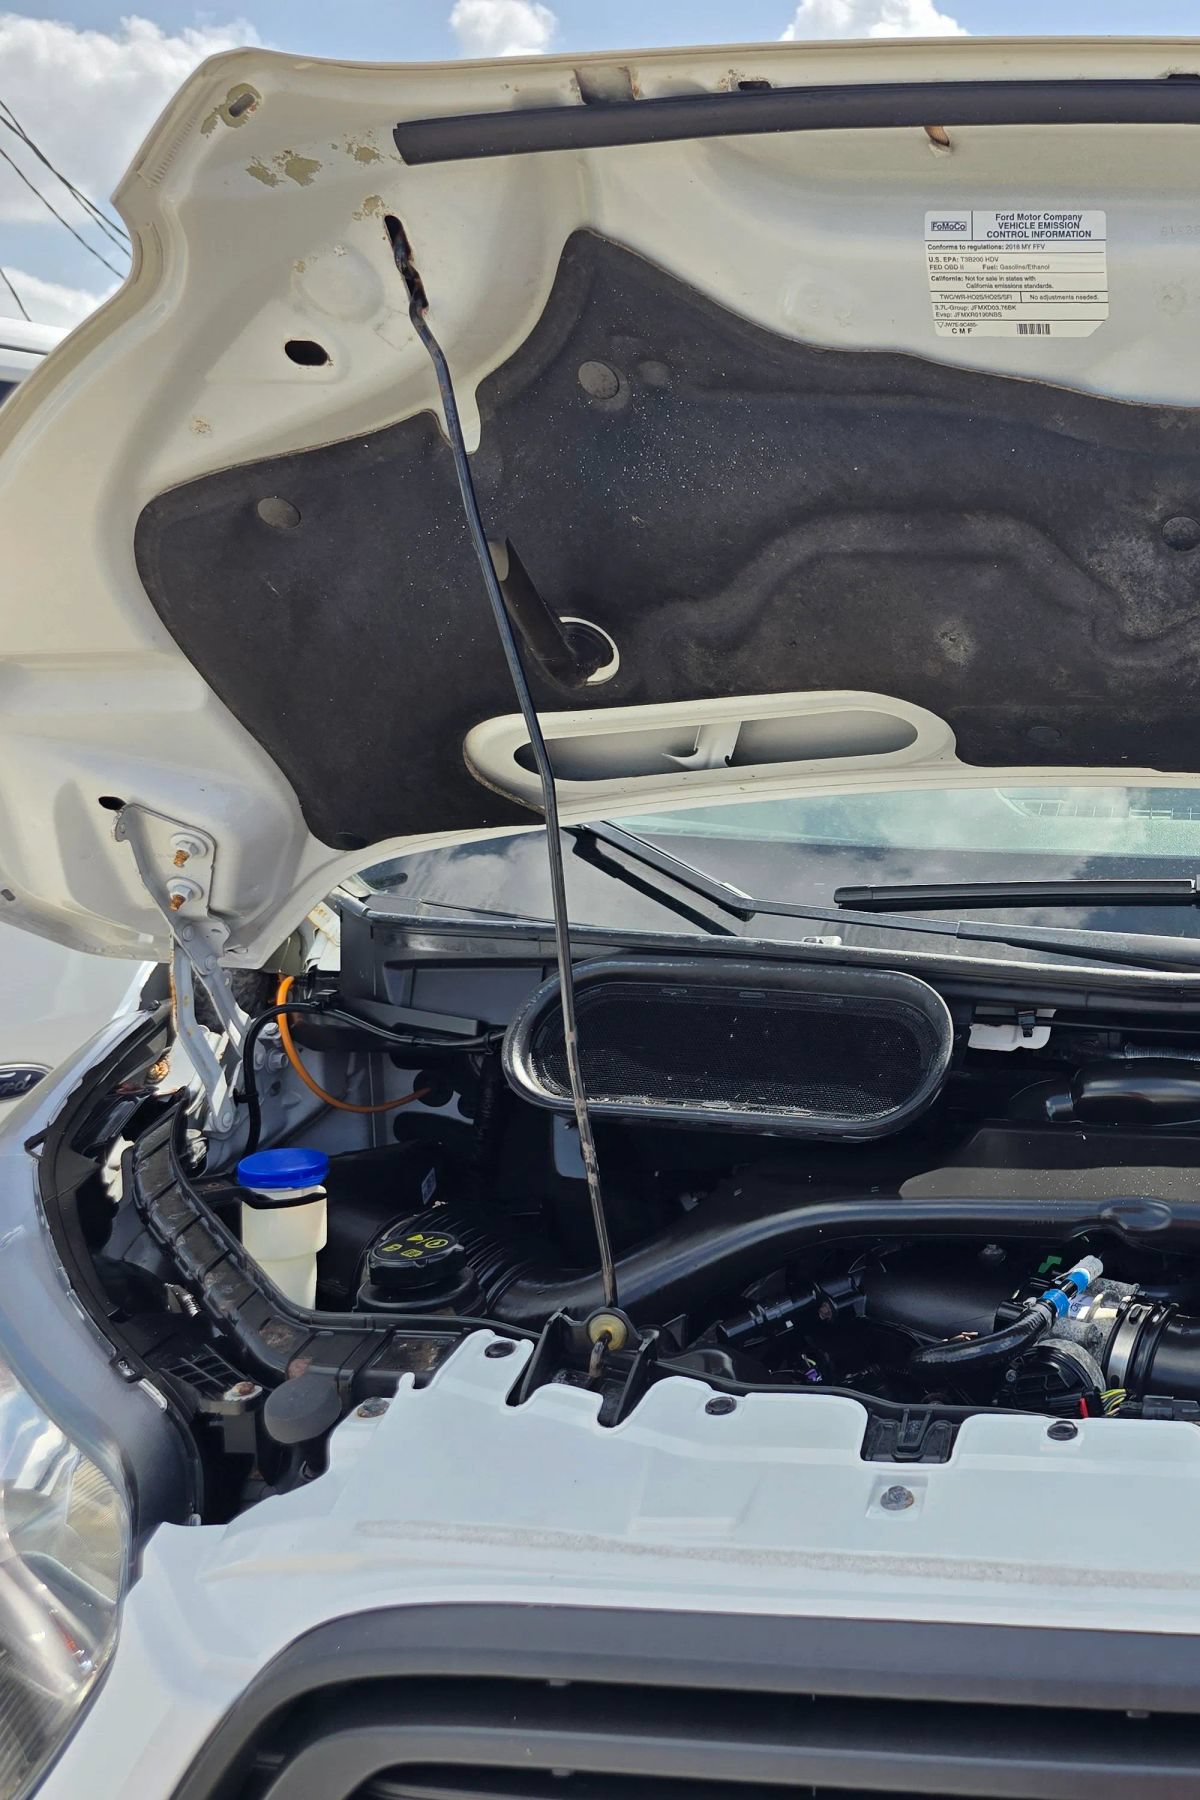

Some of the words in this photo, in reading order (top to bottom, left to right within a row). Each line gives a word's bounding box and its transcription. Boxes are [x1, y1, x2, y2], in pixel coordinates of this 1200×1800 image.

[995, 213, 1014, 221] Ford
[1017, 213, 1040, 221] Motor
[1043, 213, 1083, 222] Company
[932, 222, 966, 231] FoMoCo
[998, 222, 1035, 230] VEHICLE
[1038, 222, 1080, 230] EMISSION
[986, 230, 1029, 238] CONTROL
[1031, 230, 1092, 238] INFORMATION
